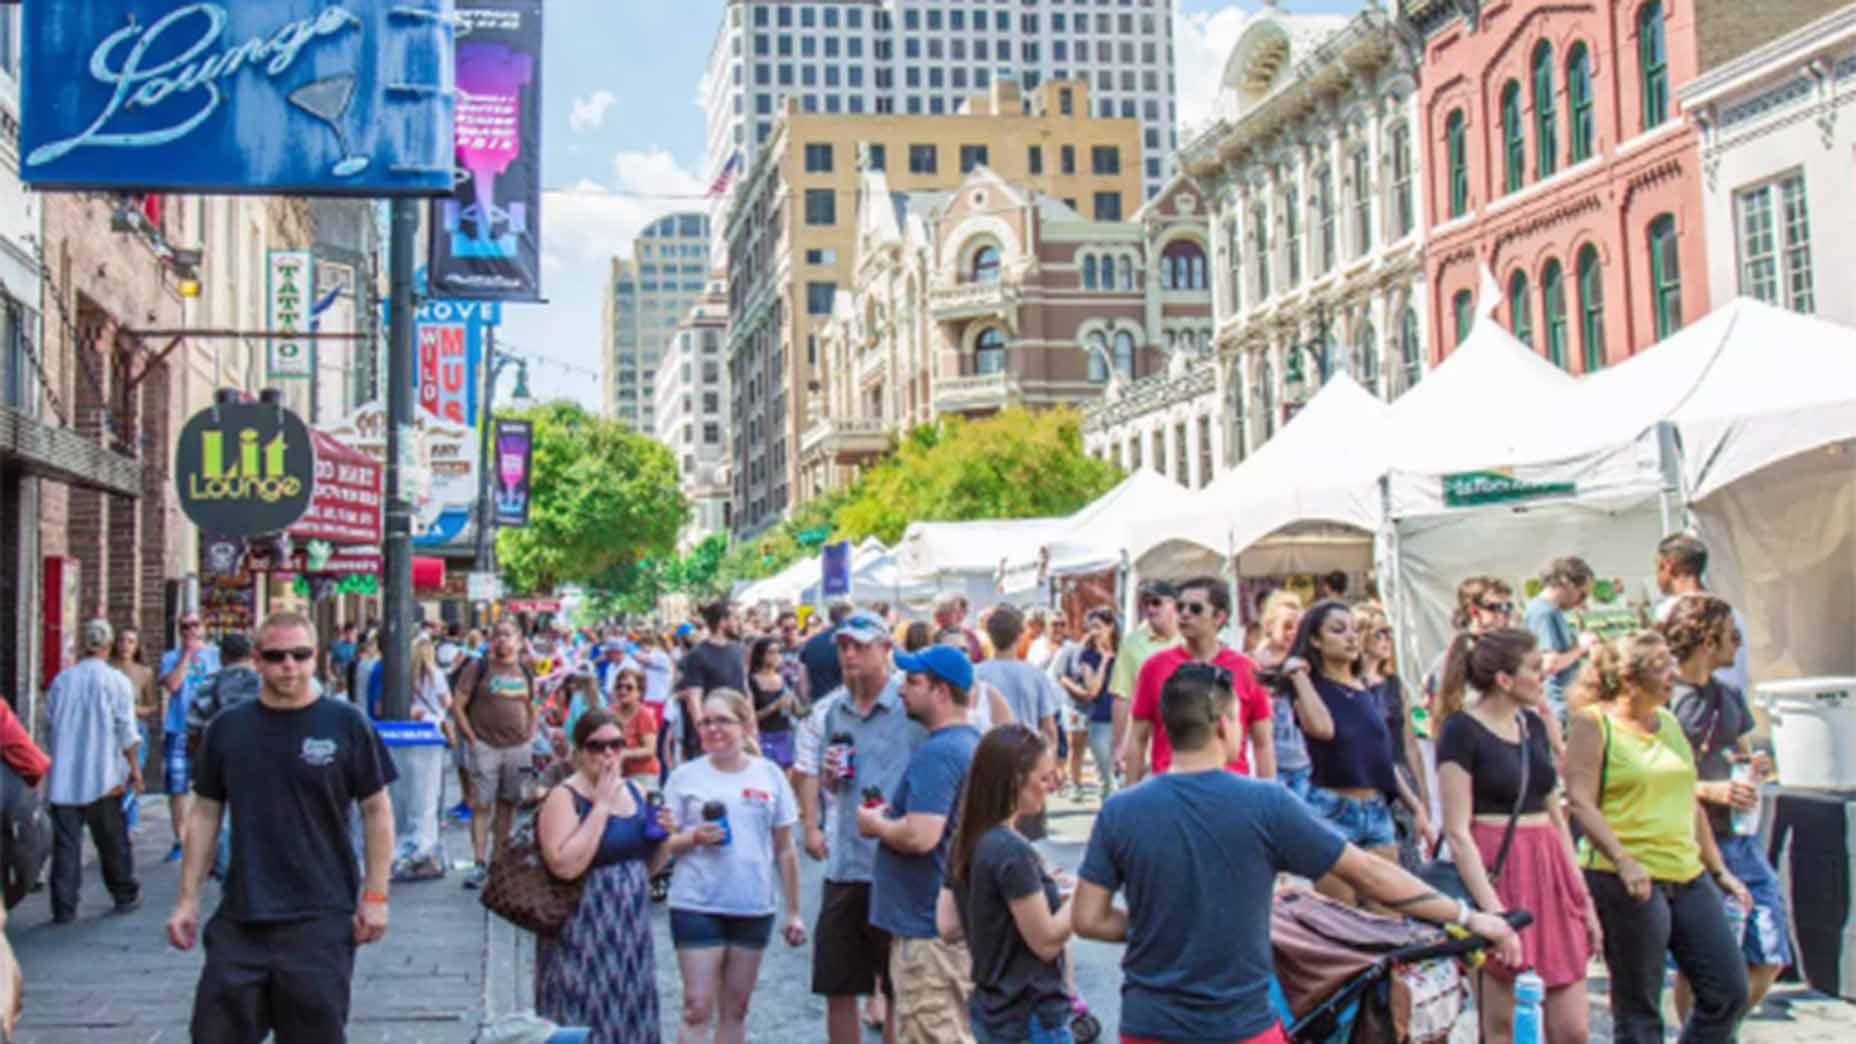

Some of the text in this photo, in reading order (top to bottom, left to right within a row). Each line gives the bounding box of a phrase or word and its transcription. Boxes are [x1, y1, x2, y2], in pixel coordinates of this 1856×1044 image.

[27, 3, 360, 165] Lounge
[202, 428, 288, 479] Lit
[189, 473, 301, 502] Lounge
